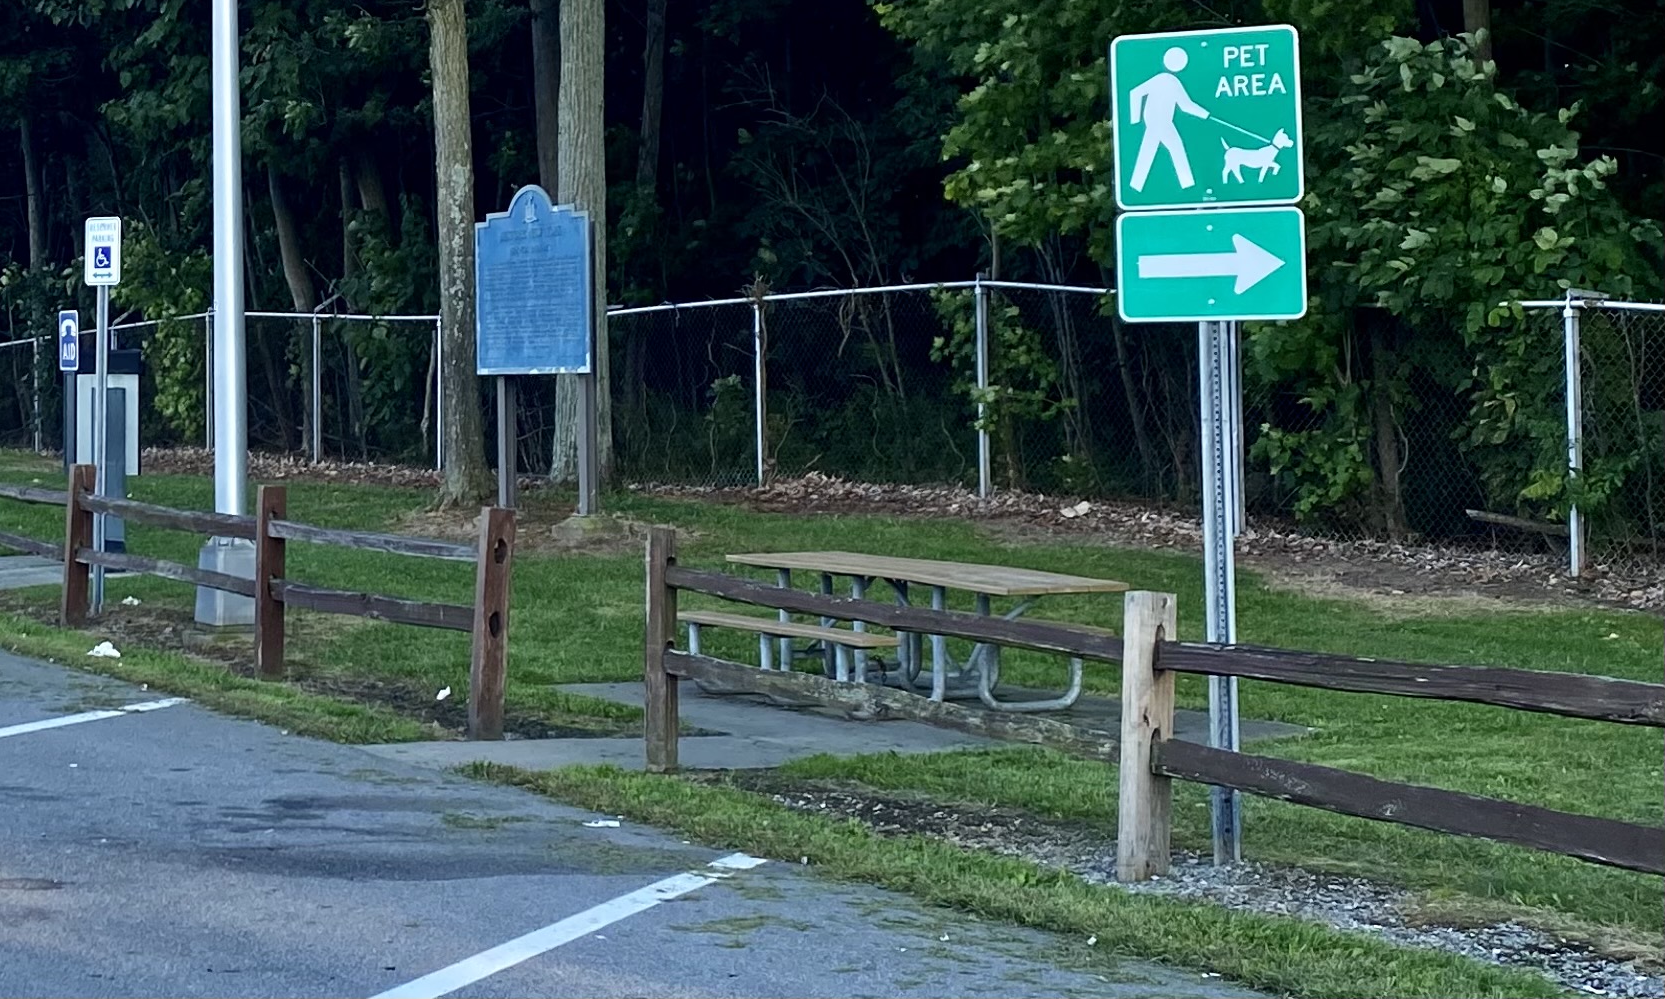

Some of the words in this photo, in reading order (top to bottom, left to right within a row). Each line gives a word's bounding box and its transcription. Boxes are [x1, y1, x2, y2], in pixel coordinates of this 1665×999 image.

[1222, 44, 1270, 69] PET
[1214, 72, 1287, 99] AREA
[62, 343, 76, 361] AID
